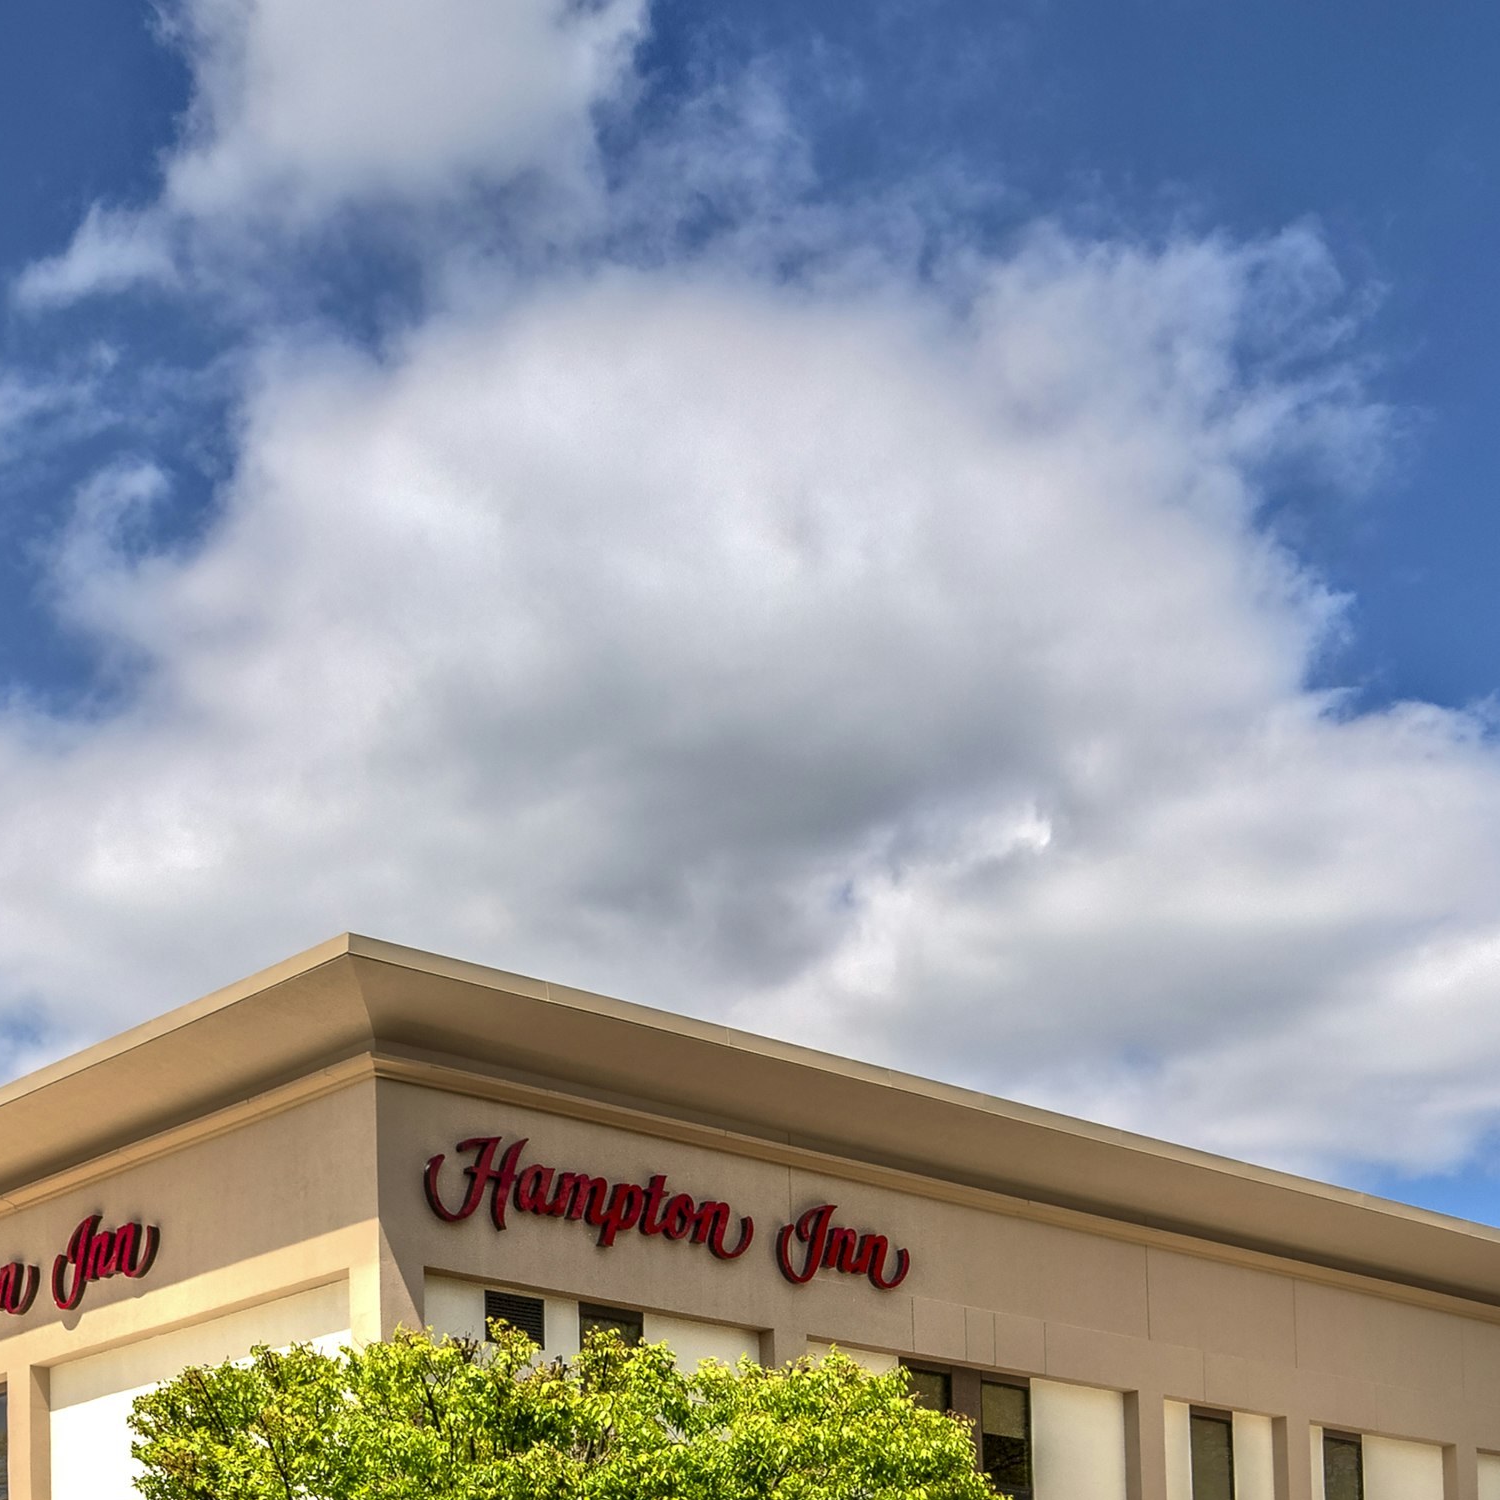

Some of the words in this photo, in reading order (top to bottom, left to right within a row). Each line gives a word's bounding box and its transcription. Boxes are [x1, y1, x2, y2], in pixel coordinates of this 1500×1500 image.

[52, 1214, 161, 1310] Inn
[424, 1136, 754, 1261] Hampton
[776, 1204, 911, 1290] Inn
